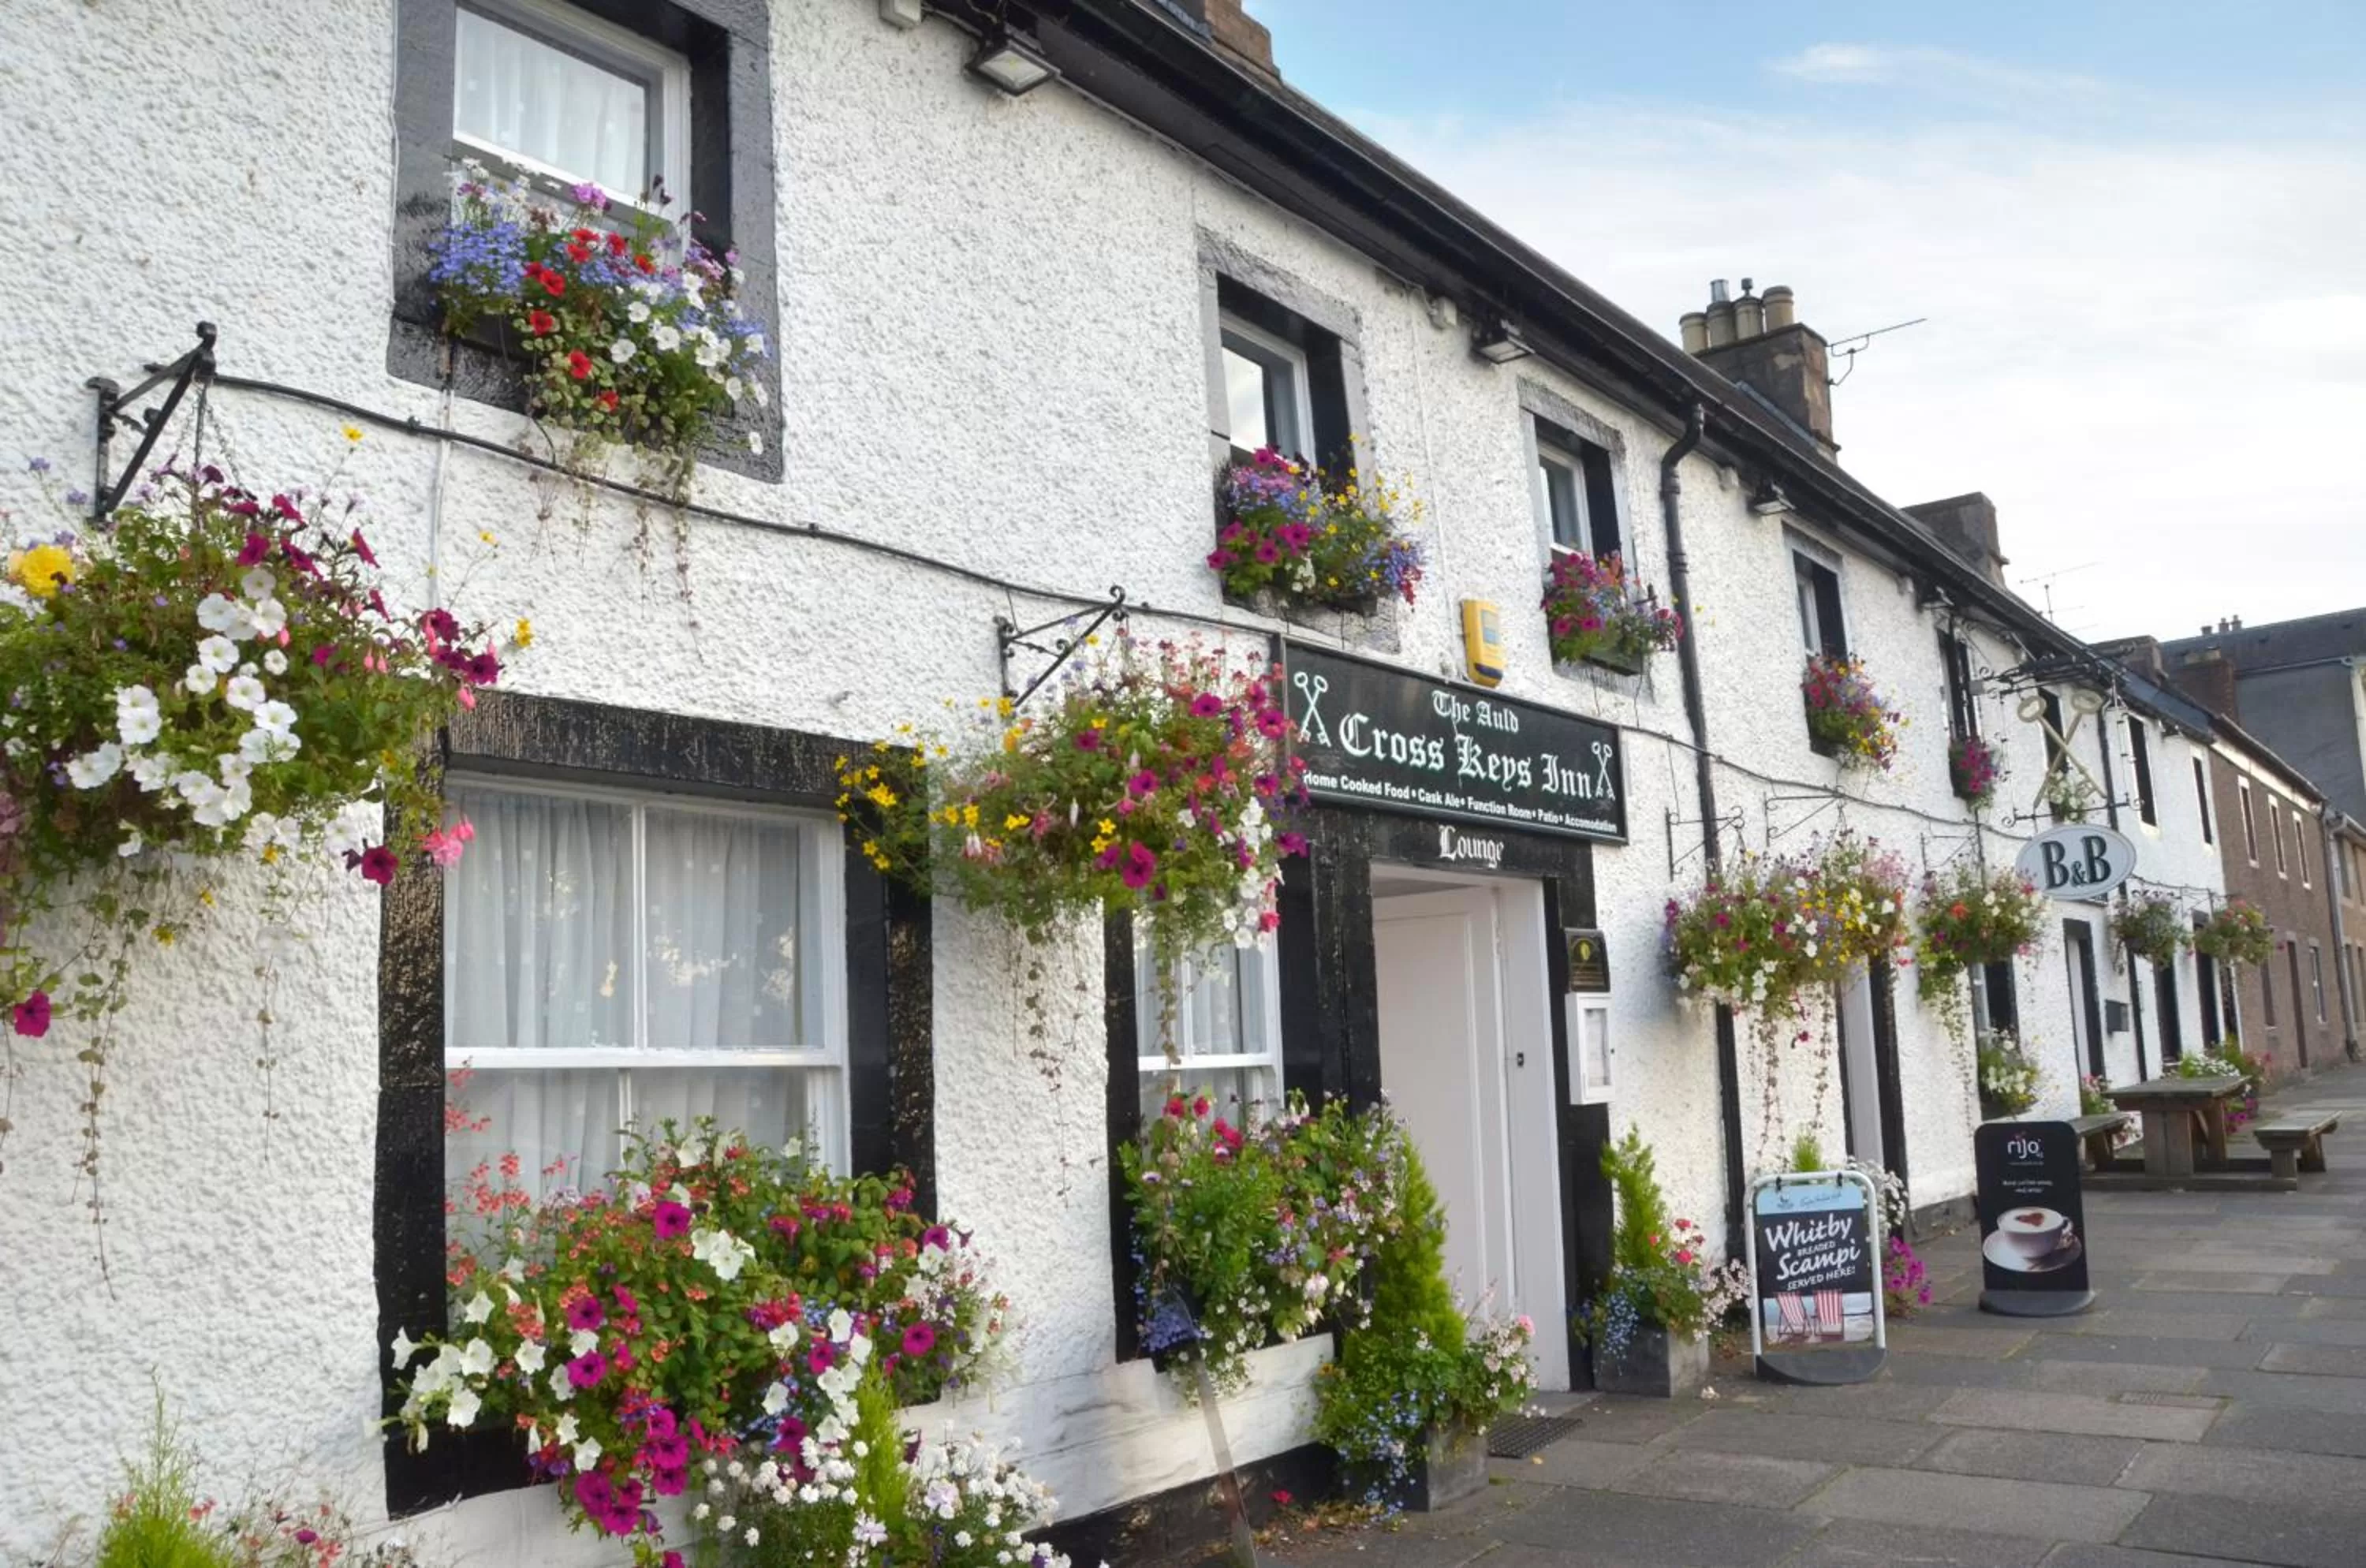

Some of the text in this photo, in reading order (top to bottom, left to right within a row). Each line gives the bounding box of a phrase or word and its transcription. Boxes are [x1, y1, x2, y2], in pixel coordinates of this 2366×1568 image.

[1431, 690, 1520, 733] The Auld
[1338, 712, 1592, 799] Cross Keys Inn
[1304, 770, 1338, 788] Home
[1341, 775, 1382, 795] Cooked
[1385, 782, 1410, 799] Food
[1418, 788, 1442, 805] Cask
[1444, 792, 1461, 808] Ale
[1467, 796, 1506, 815] Function
[1507, 803, 1532, 820] Room
[1537, 808, 1559, 824] Patio
[1439, 825, 1504, 868] Lounge
[2039, 835, 2111, 889] B&B
[1765, 1213, 1853, 1252] Whitby
[1797, 1240, 1836, 1256] BREADED
[1776, 1238, 1860, 1279] Scampi
[1787, 1274, 1824, 1290] SERVED
